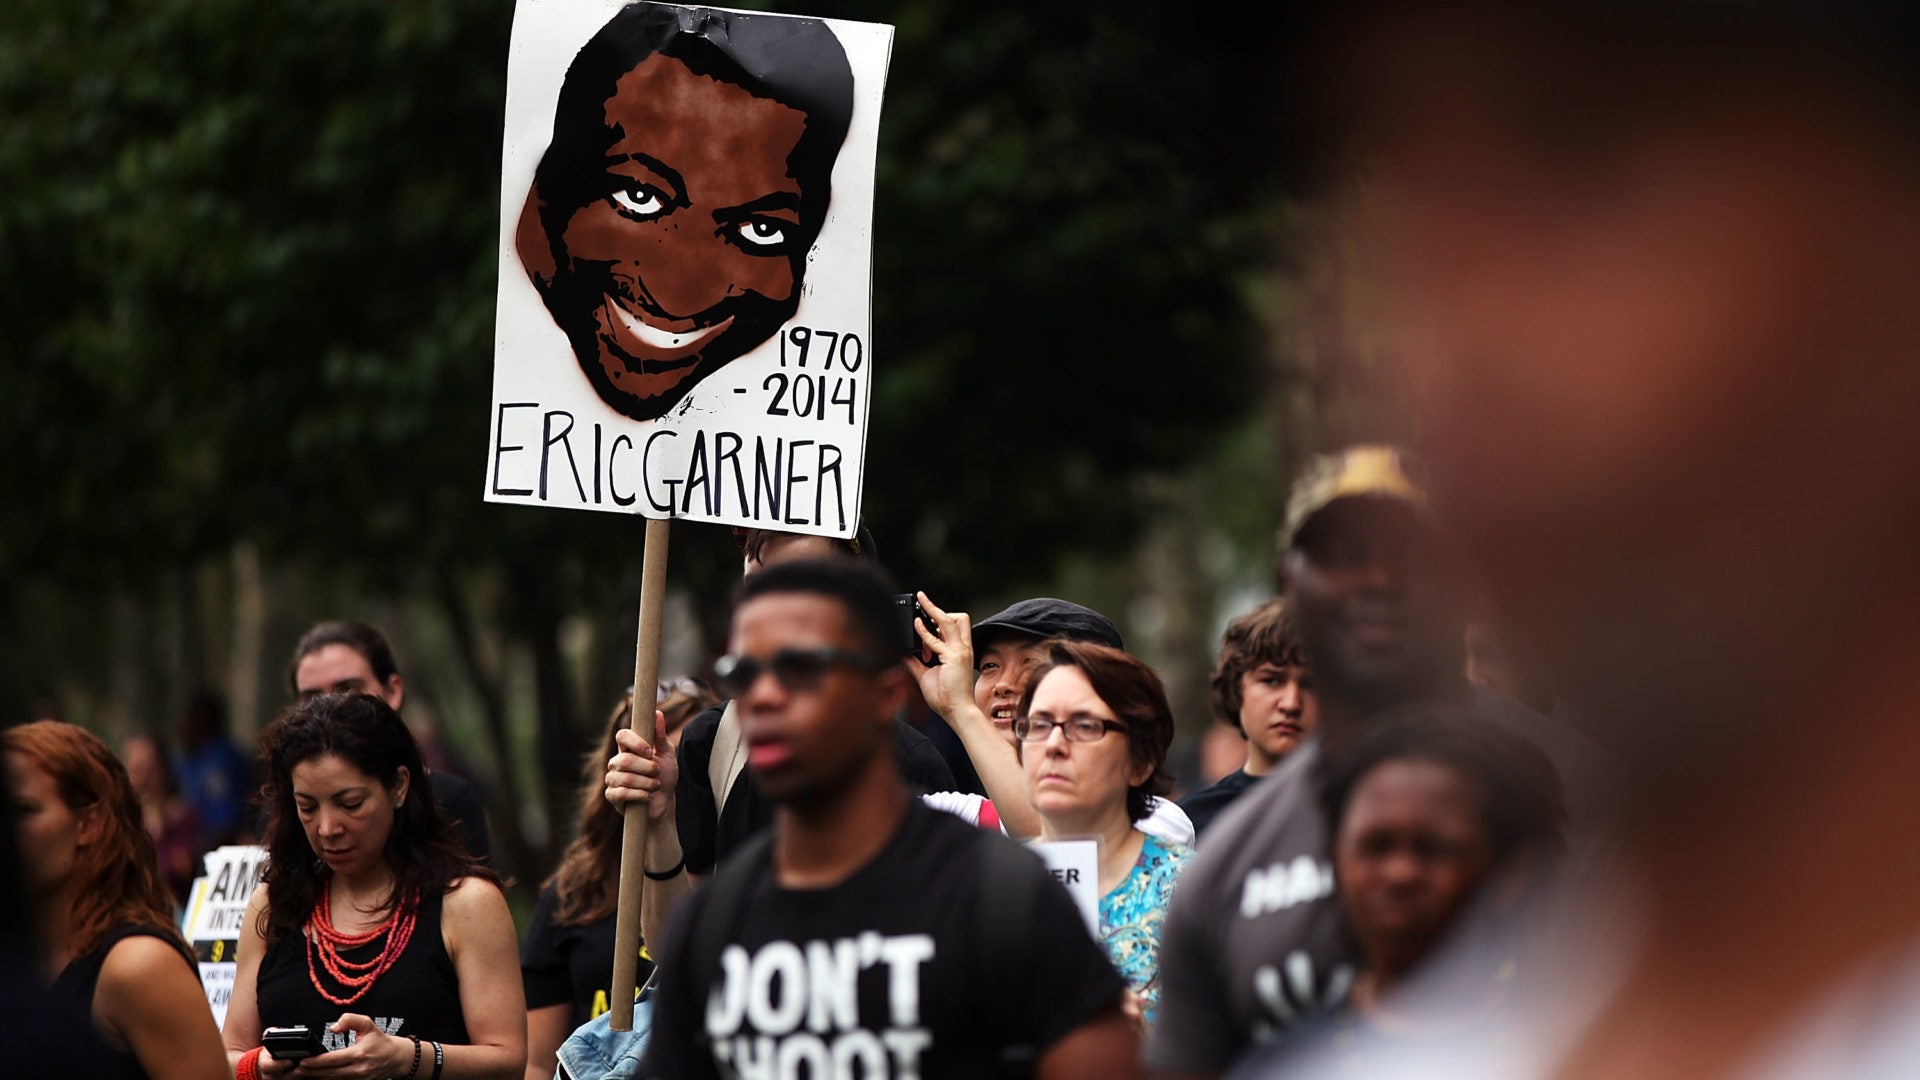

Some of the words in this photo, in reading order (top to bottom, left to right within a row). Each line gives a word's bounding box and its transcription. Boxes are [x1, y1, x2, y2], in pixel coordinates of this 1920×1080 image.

[779, 326, 863, 372] 1970
[762, 373, 856, 424] 2014
[493, 402, 636, 506] ERIC
[642, 429, 846, 531] GARNER
